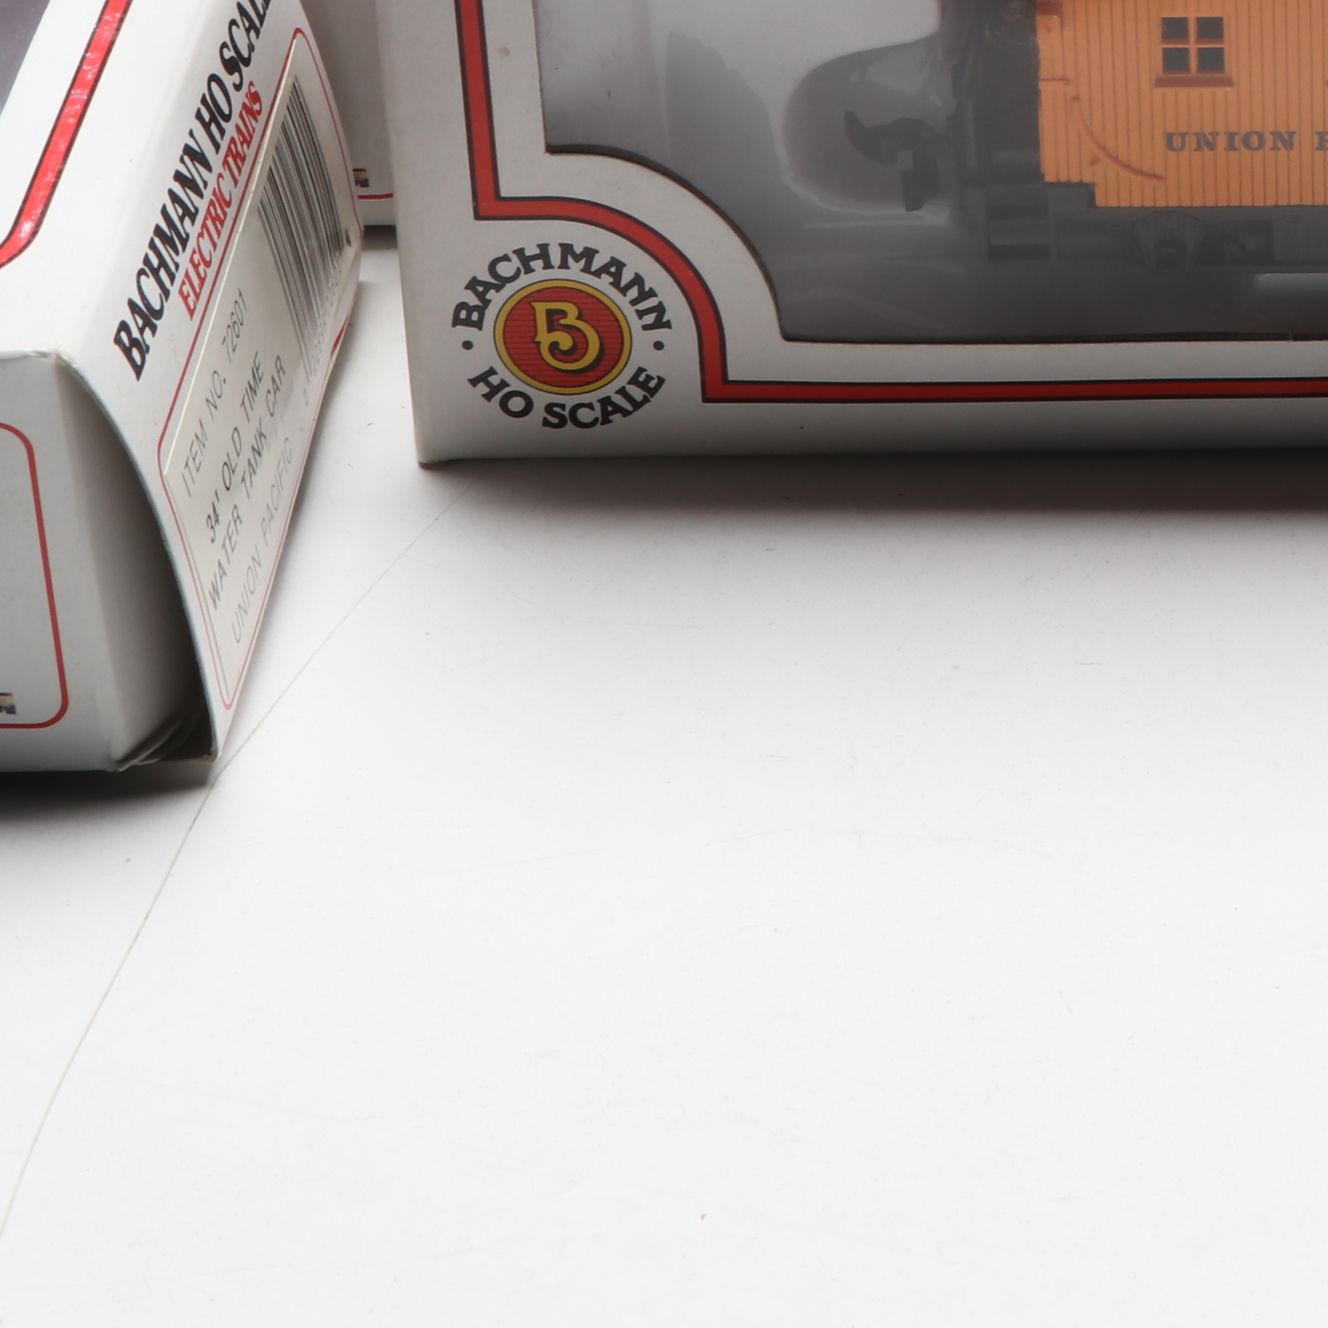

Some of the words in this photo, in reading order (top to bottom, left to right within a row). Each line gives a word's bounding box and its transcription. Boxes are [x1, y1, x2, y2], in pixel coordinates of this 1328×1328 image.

[177, 172, 233, 322] ELECTRIC
[221, 80, 264, 190] TRAINS
[1162, 129, 1298, 153] UNION
[113, 128, 214, 382] BACHMANN
[194, 72, 233, 155] HO
[450, 241, 674, 333] BACHMANN
[180, 417, 209, 499] ITEM
[204, 369, 228, 423] NO.
[221, 425, 243, 493] OLD
[239, 350, 266, 424] TIME
[466, 365, 535, 420] HO
[540, 365, 668, 431] SCALE
[207, 502, 244, 612] WATER
[239, 415, 268, 501] TANK
[264, 353, 287, 419] CAR
[231, 542, 264, 646] UNION
